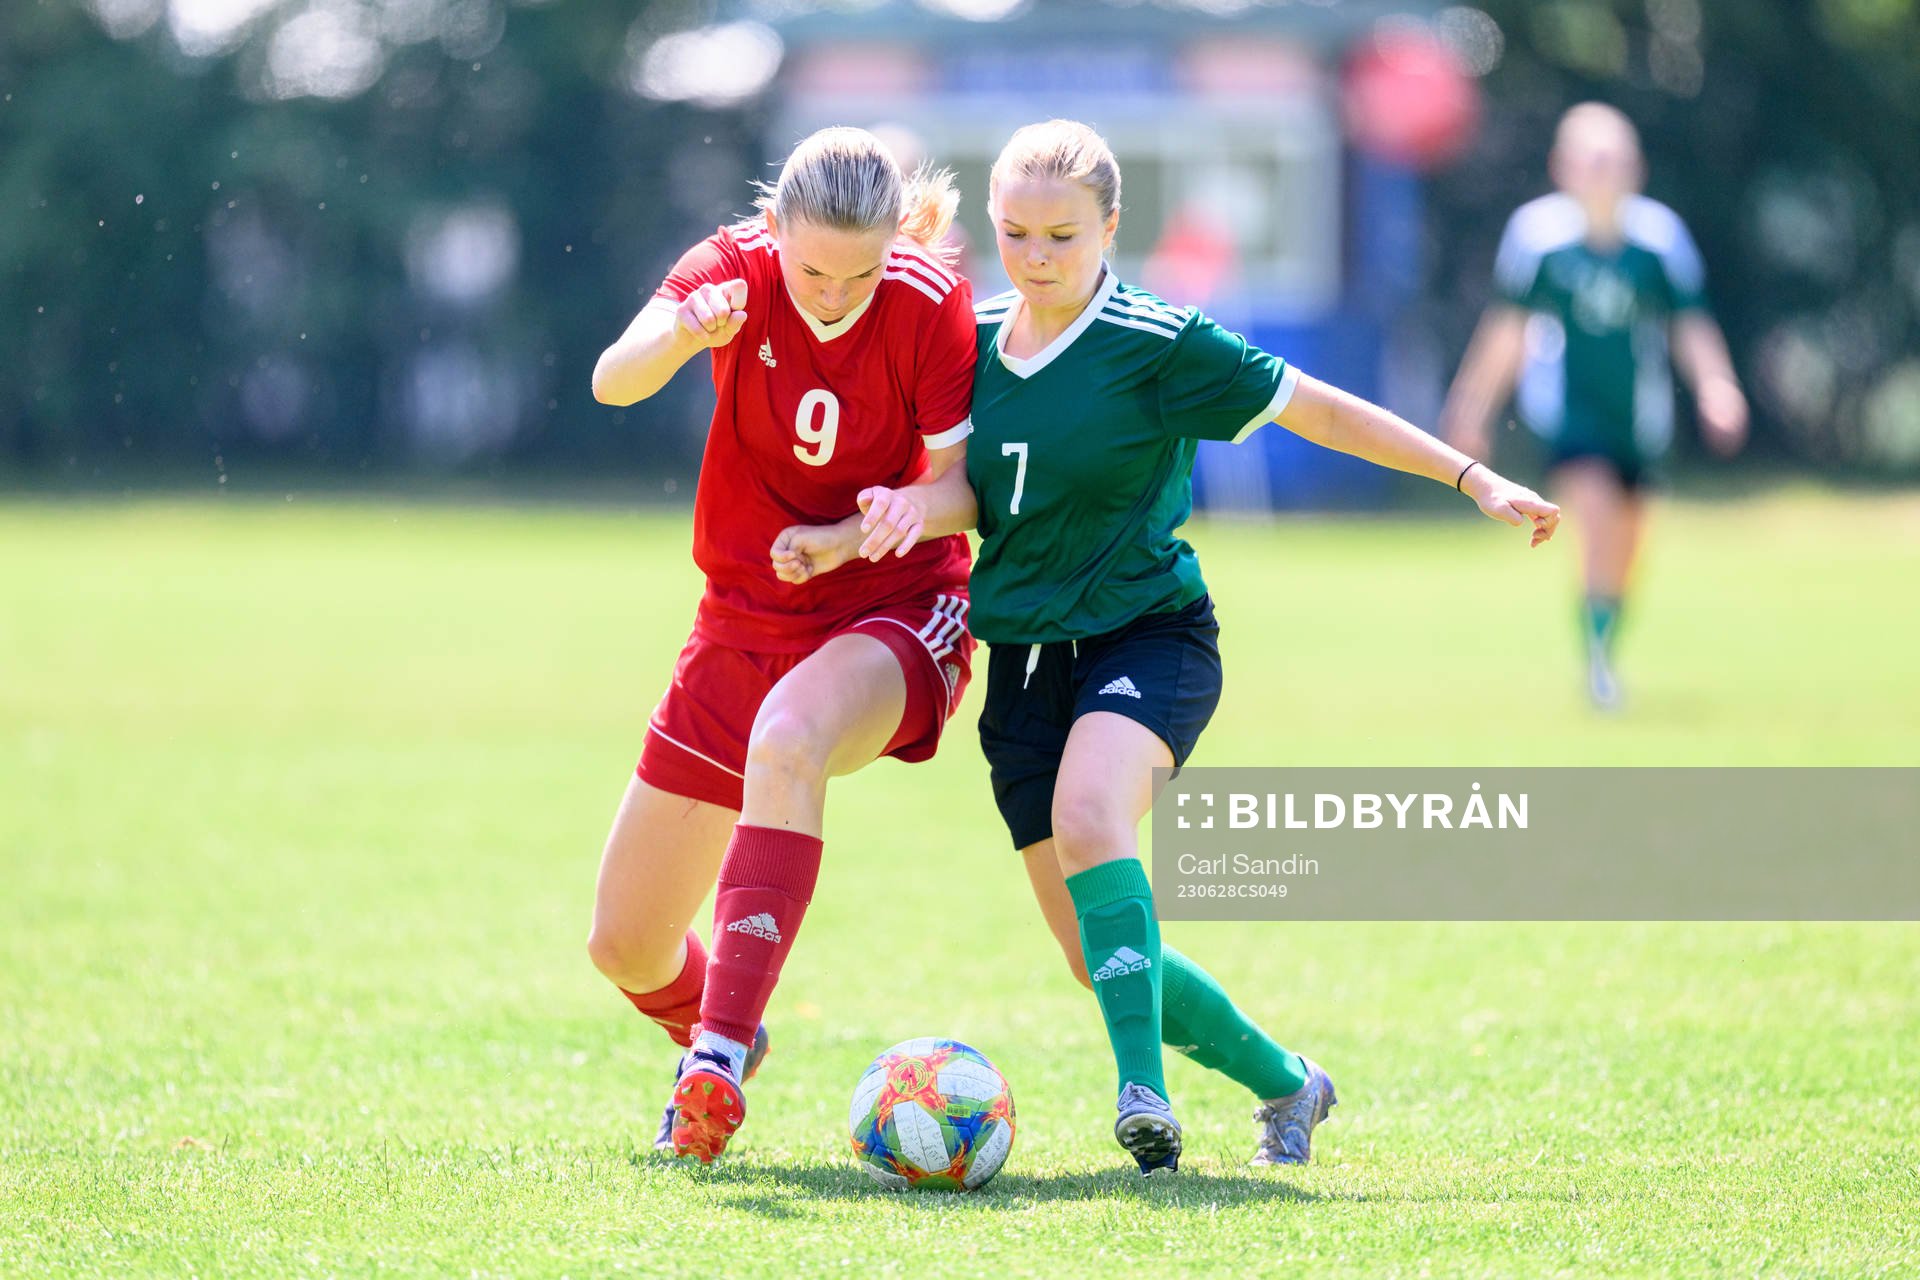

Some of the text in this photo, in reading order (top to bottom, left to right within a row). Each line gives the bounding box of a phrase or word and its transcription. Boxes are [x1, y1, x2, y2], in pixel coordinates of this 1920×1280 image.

[793, 388, 840, 467] 9
[1001, 442, 1029, 515] 7
[726, 919, 782, 944] adidas
[1093, 958, 1152, 982] adidas
